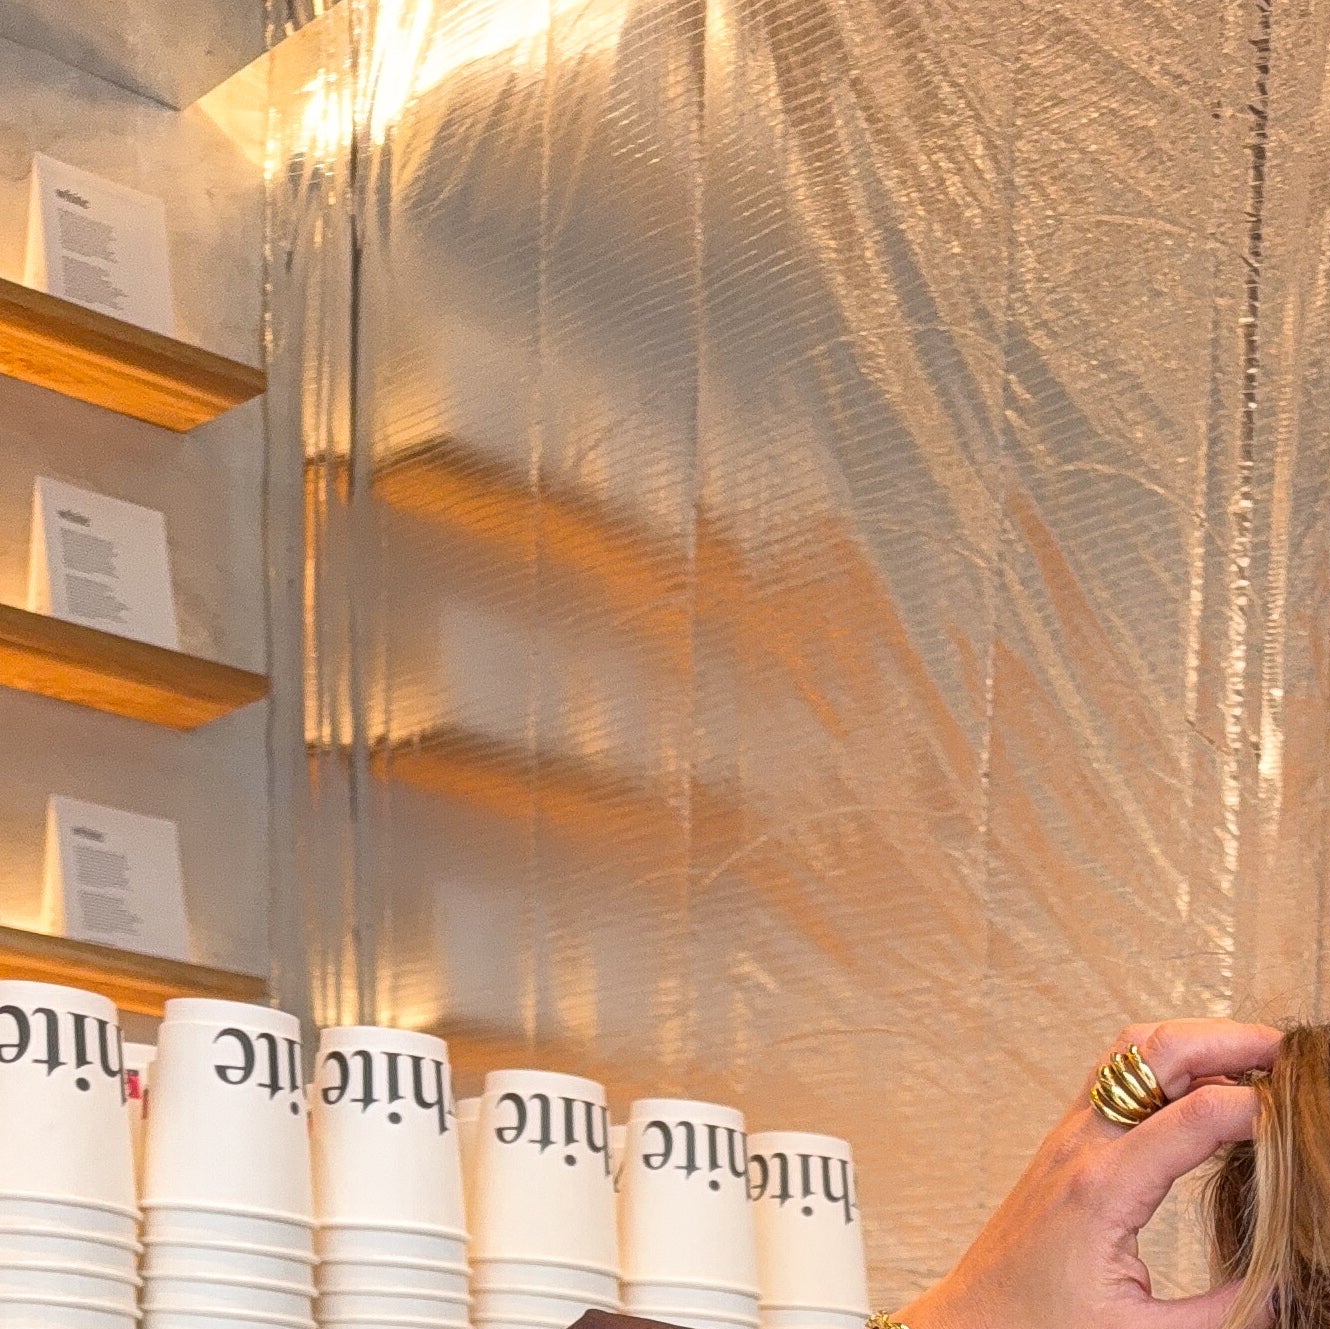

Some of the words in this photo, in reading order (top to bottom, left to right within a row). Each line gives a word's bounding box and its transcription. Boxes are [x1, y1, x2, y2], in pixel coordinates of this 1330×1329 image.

[213, 1027, 303, 1116] ite
[321, 1049, 451, 1135] hite
[749, 1151, 856, 1224] hite
